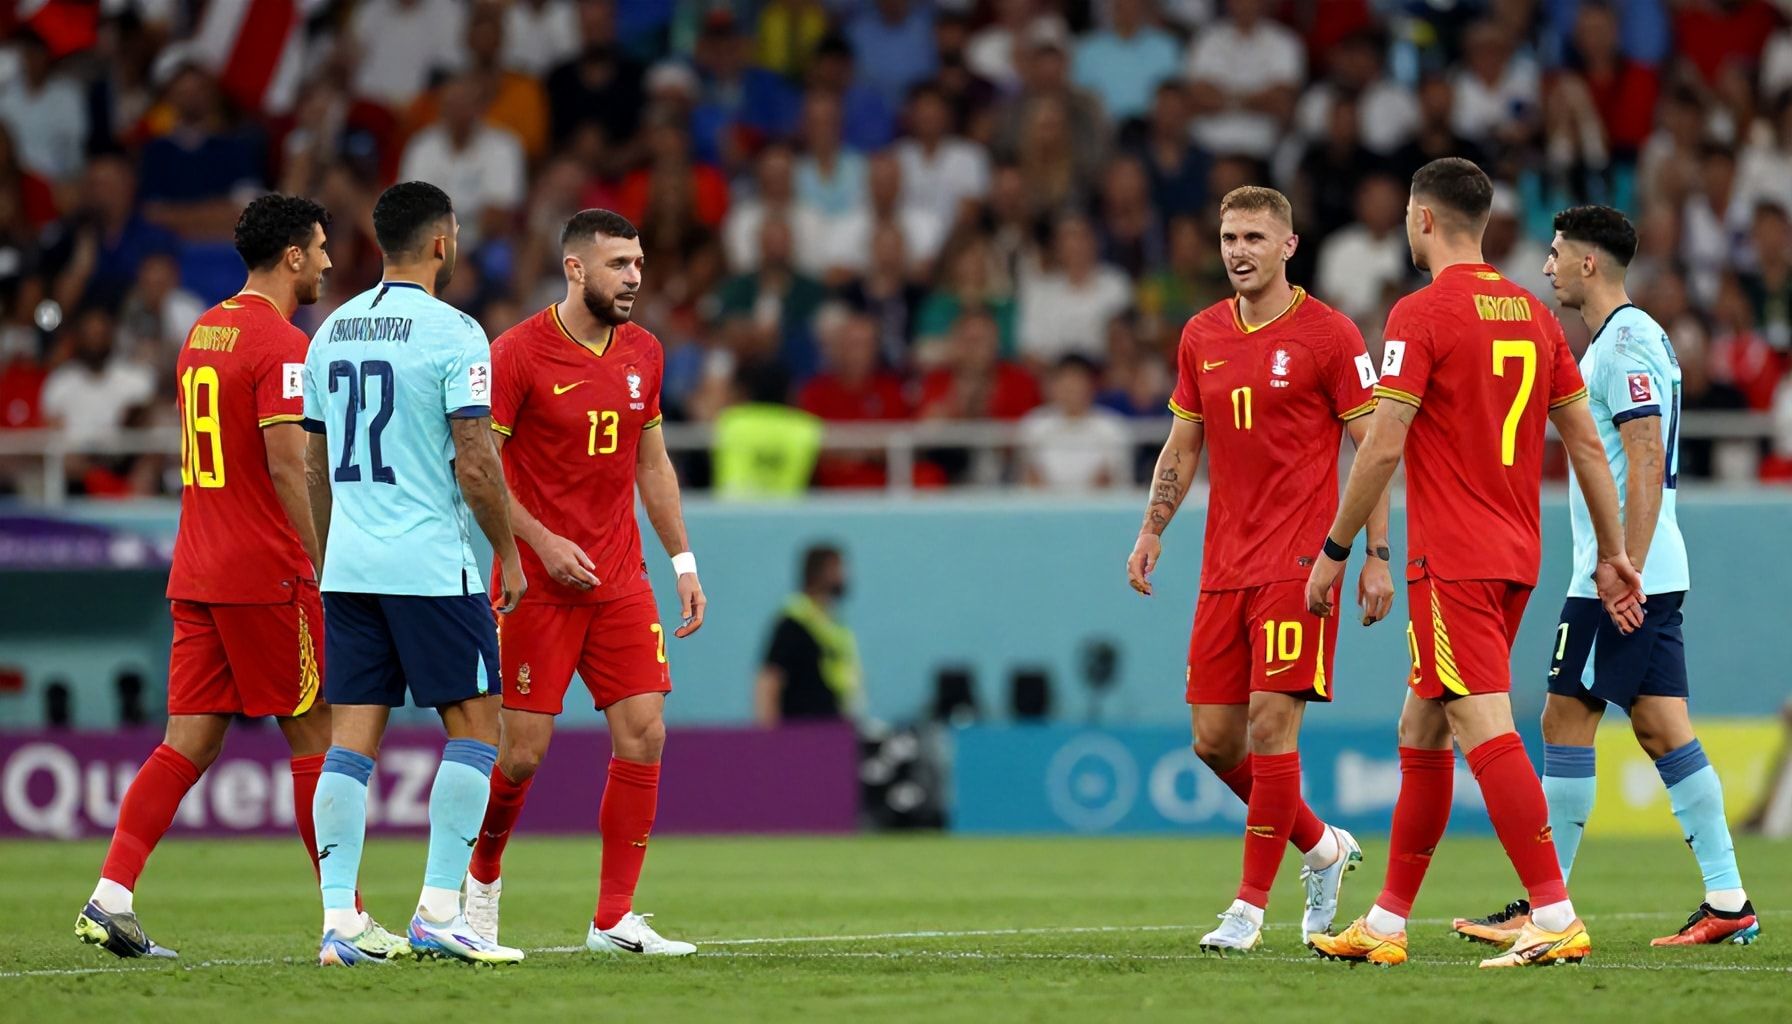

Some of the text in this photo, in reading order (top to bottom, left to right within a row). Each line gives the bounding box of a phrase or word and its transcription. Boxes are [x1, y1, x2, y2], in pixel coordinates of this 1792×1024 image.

[1493, 340, 1536, 466] 7
[587, 410, 620, 456] 13
[1263, 620, 1303, 663] 10
